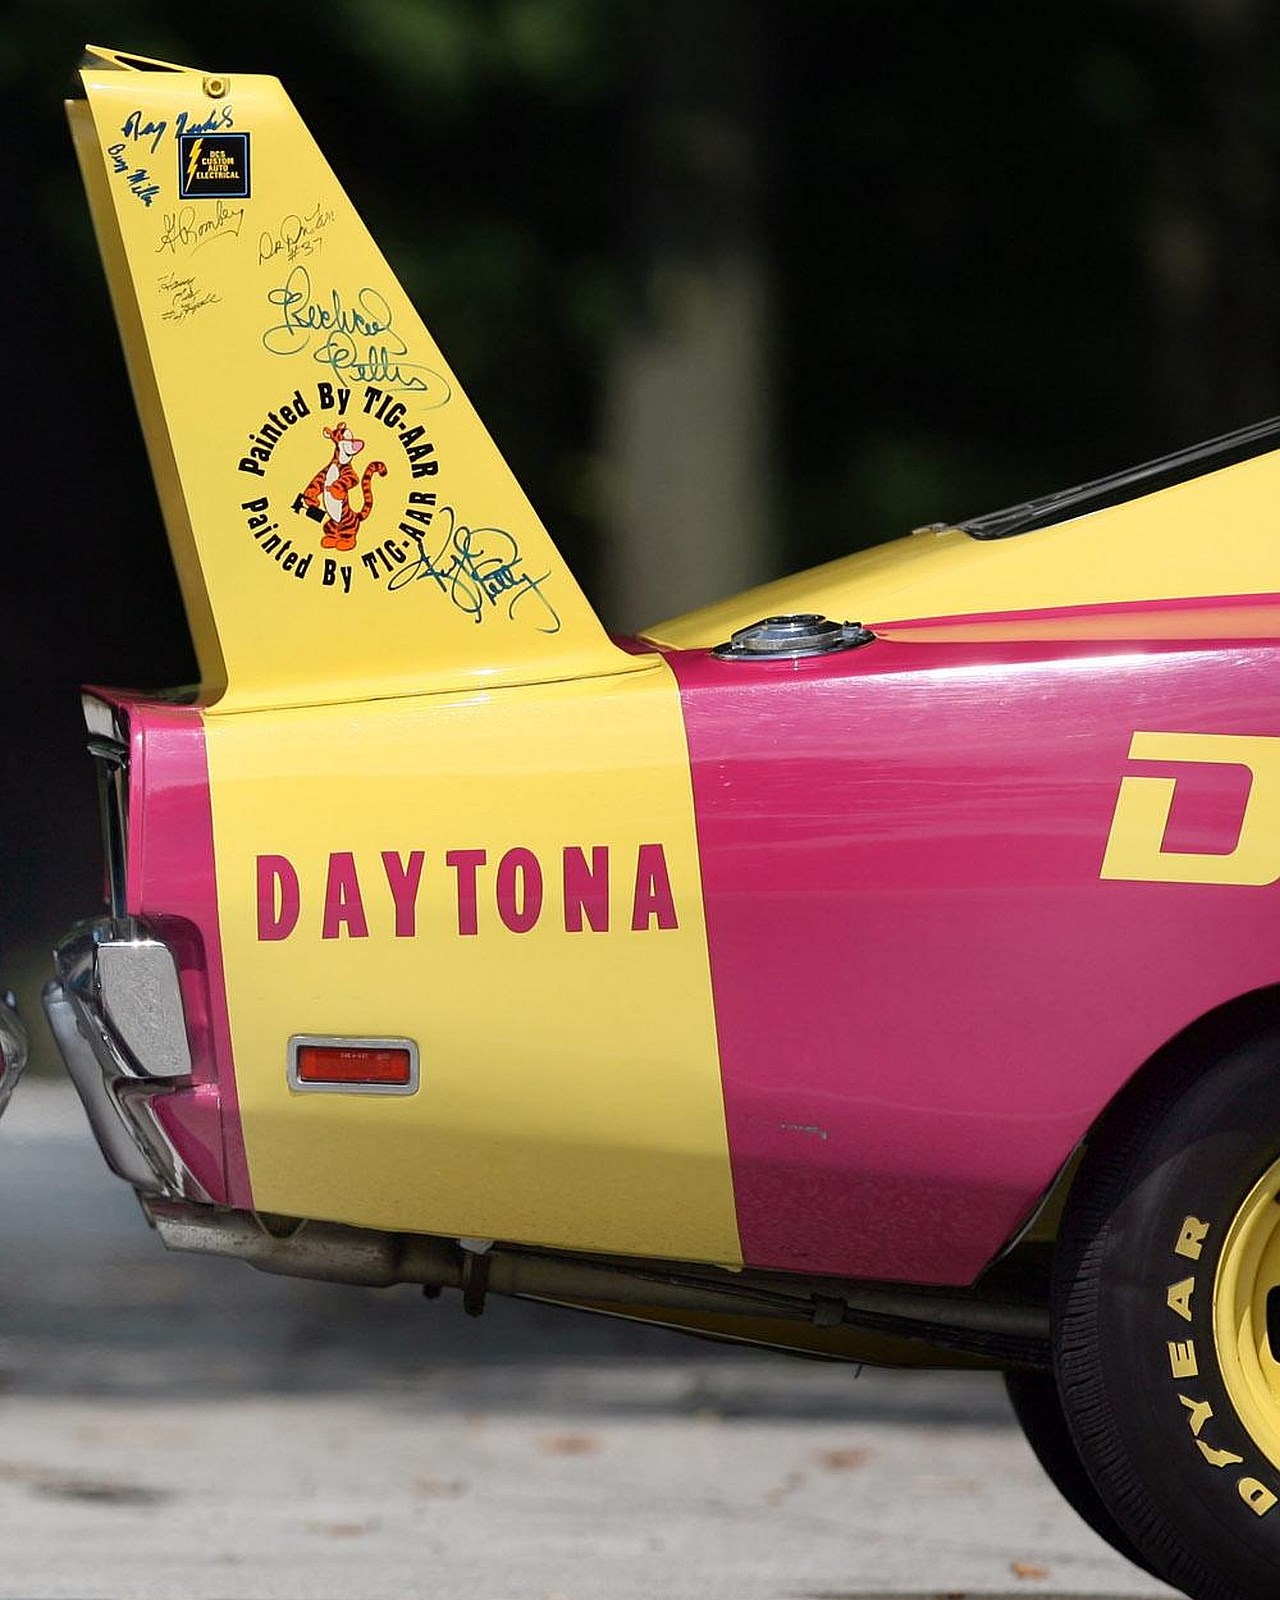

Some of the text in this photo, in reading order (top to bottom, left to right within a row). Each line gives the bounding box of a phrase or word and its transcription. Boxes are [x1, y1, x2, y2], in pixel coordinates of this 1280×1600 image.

[195, 171, 241, 180] ELECTRICAL
[201, 157, 235, 166] CUSTOM
[207, 164, 229, 173] AUTO
[237, 389, 312, 477] Painted
[317, 381, 352, 415] By
[241, 496, 313, 580] Painted
[322, 557, 353, 593] By
[255, 843, 680, 942] DAYTONA
